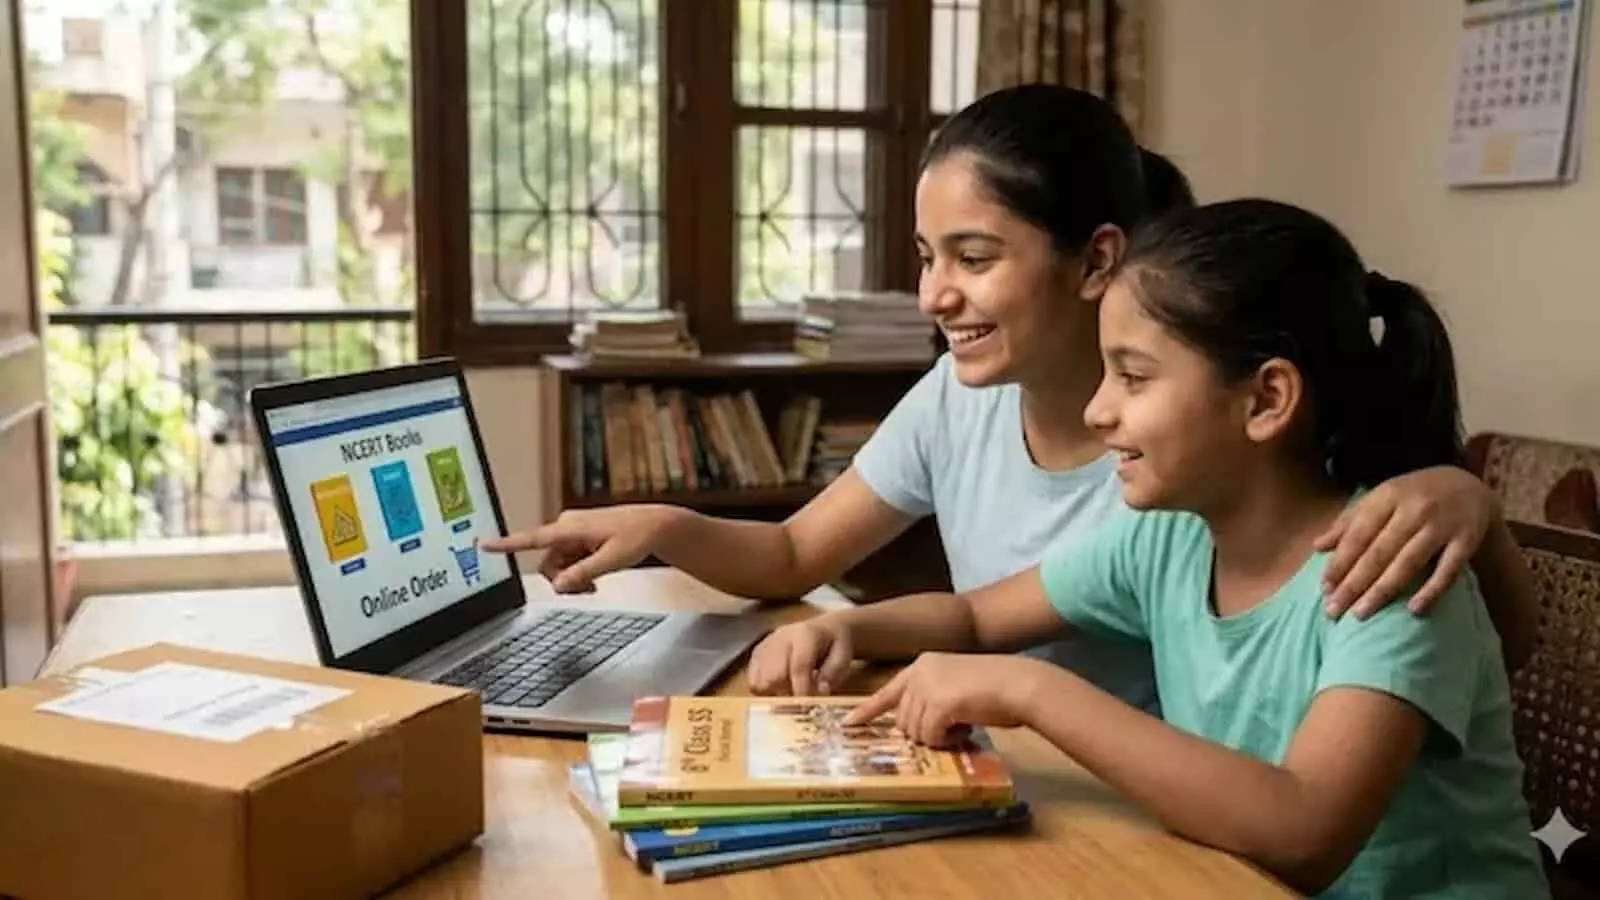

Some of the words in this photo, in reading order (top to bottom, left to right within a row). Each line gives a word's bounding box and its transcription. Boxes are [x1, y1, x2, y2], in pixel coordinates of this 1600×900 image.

[340, 435, 384, 464] NCERT
[385, 429, 423, 453] Books
[361, 586, 409, 619] Online
[409, 569, 449, 597] Order
[683, 725, 712, 755] Class
[645, 791, 694, 802] NCERT
